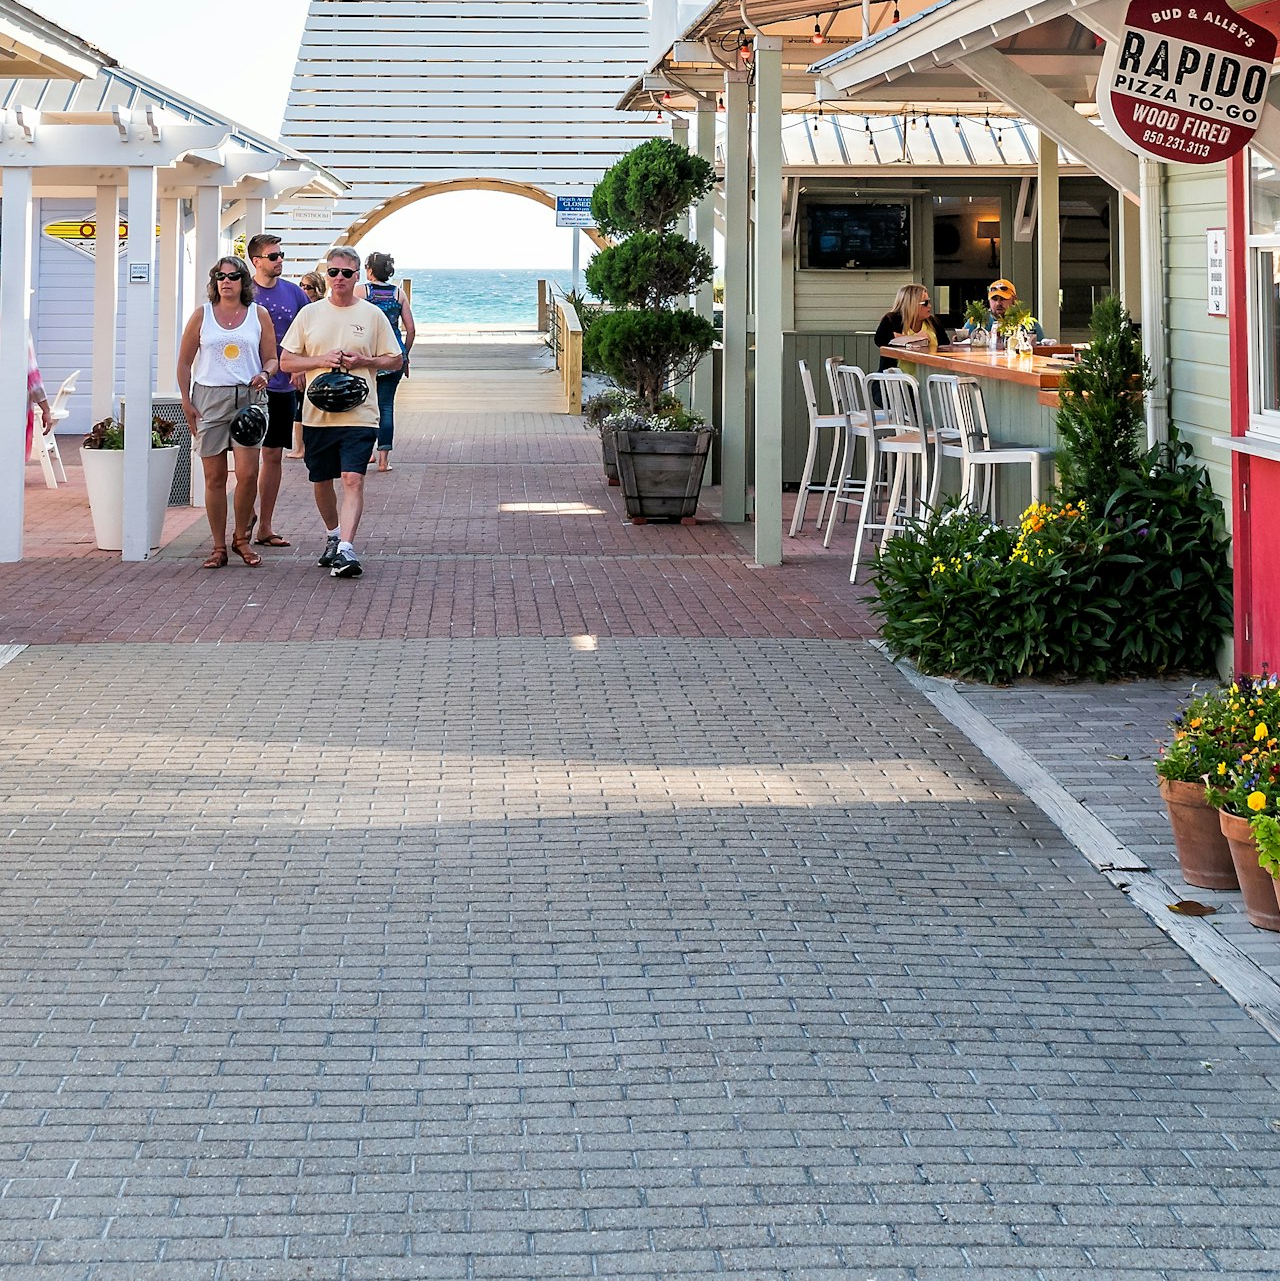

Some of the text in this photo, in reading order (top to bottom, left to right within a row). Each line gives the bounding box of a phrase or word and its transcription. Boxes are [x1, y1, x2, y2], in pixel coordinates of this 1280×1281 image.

[1151, 8, 1255, 48] BUD & ALLEY'S
[1119, 31, 1267, 104] RAPIDO
[1115, 74, 1257, 122] PIZZA TO-GO
[1133, 103, 1231, 145] WOOD FIRED
[1143, 130, 1210, 157] 850.231.3113
